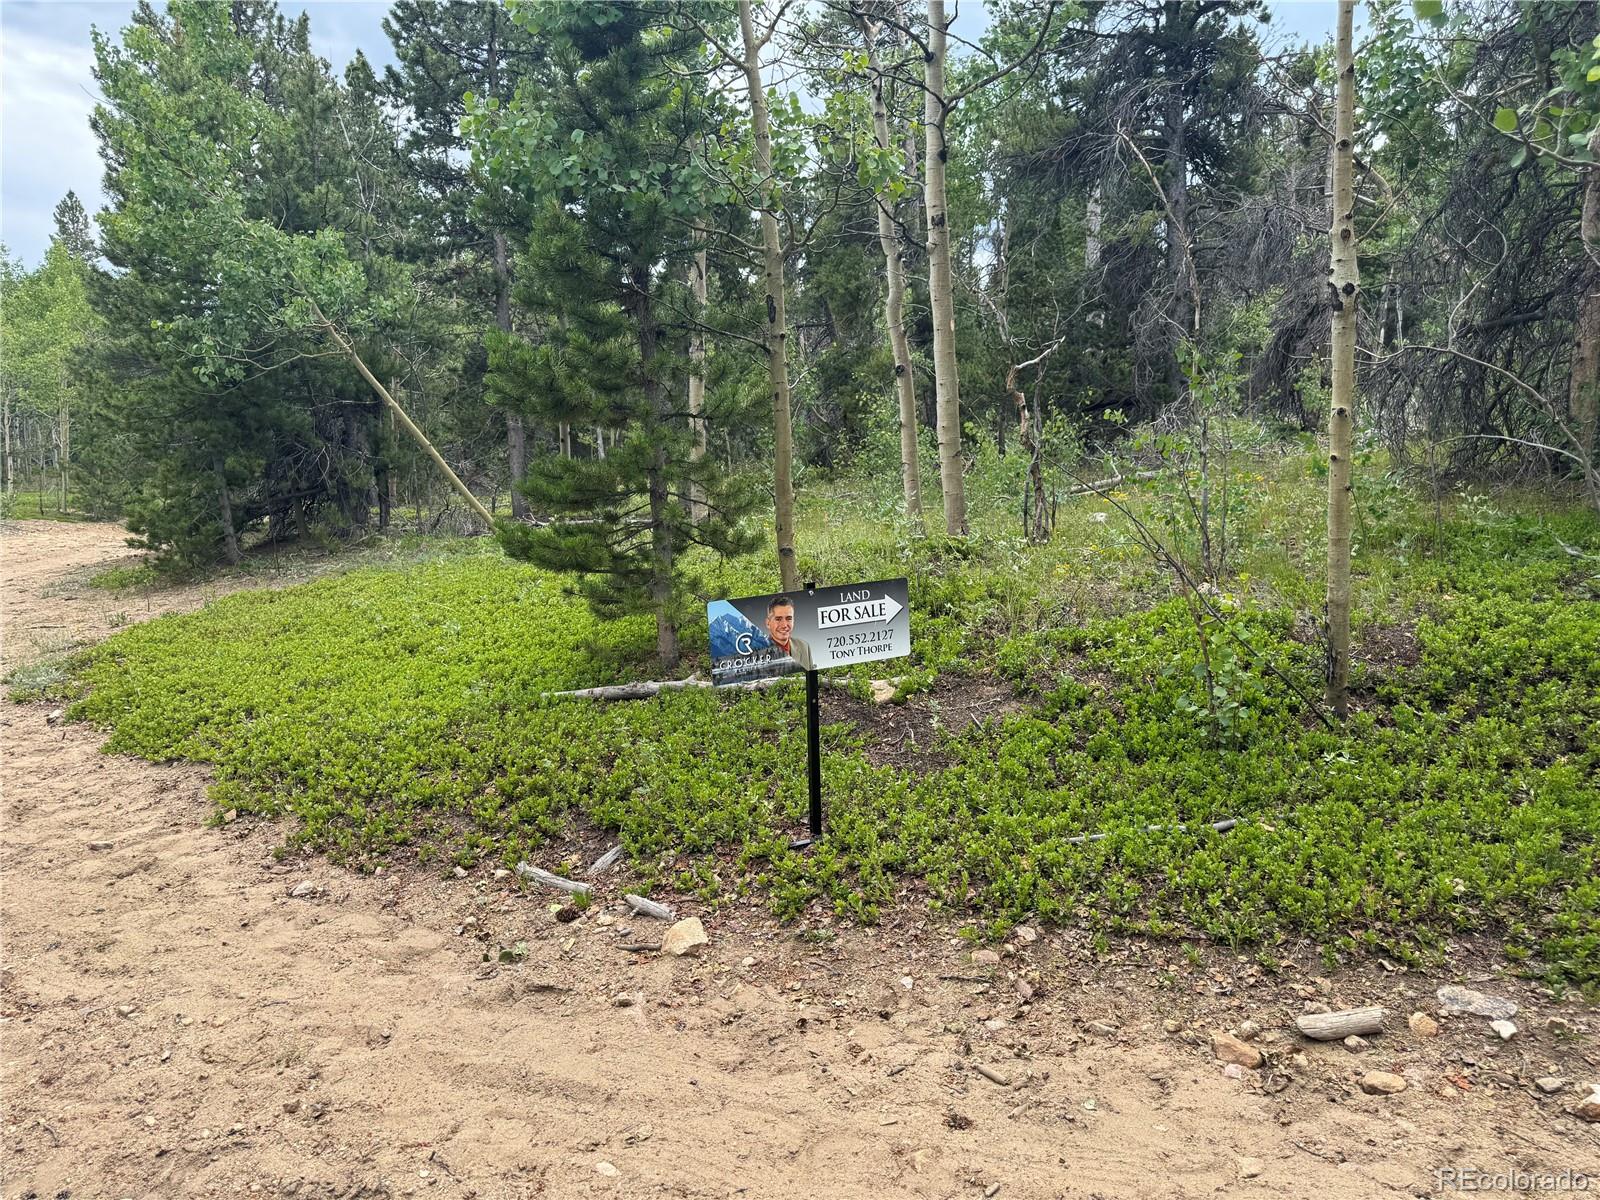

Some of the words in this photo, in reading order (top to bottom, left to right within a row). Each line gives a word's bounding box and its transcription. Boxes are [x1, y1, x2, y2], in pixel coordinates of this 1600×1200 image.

[840, 589, 870, 603] LAND
[820, 608, 851, 625] FOR
[854, 602, 887, 620] SALE
[826, 629, 894, 649] 720.552.2127
[829, 648, 856, 660] TONY
[857, 643, 893, 656] THORPE
[719, 654, 772, 670] CROCKER
